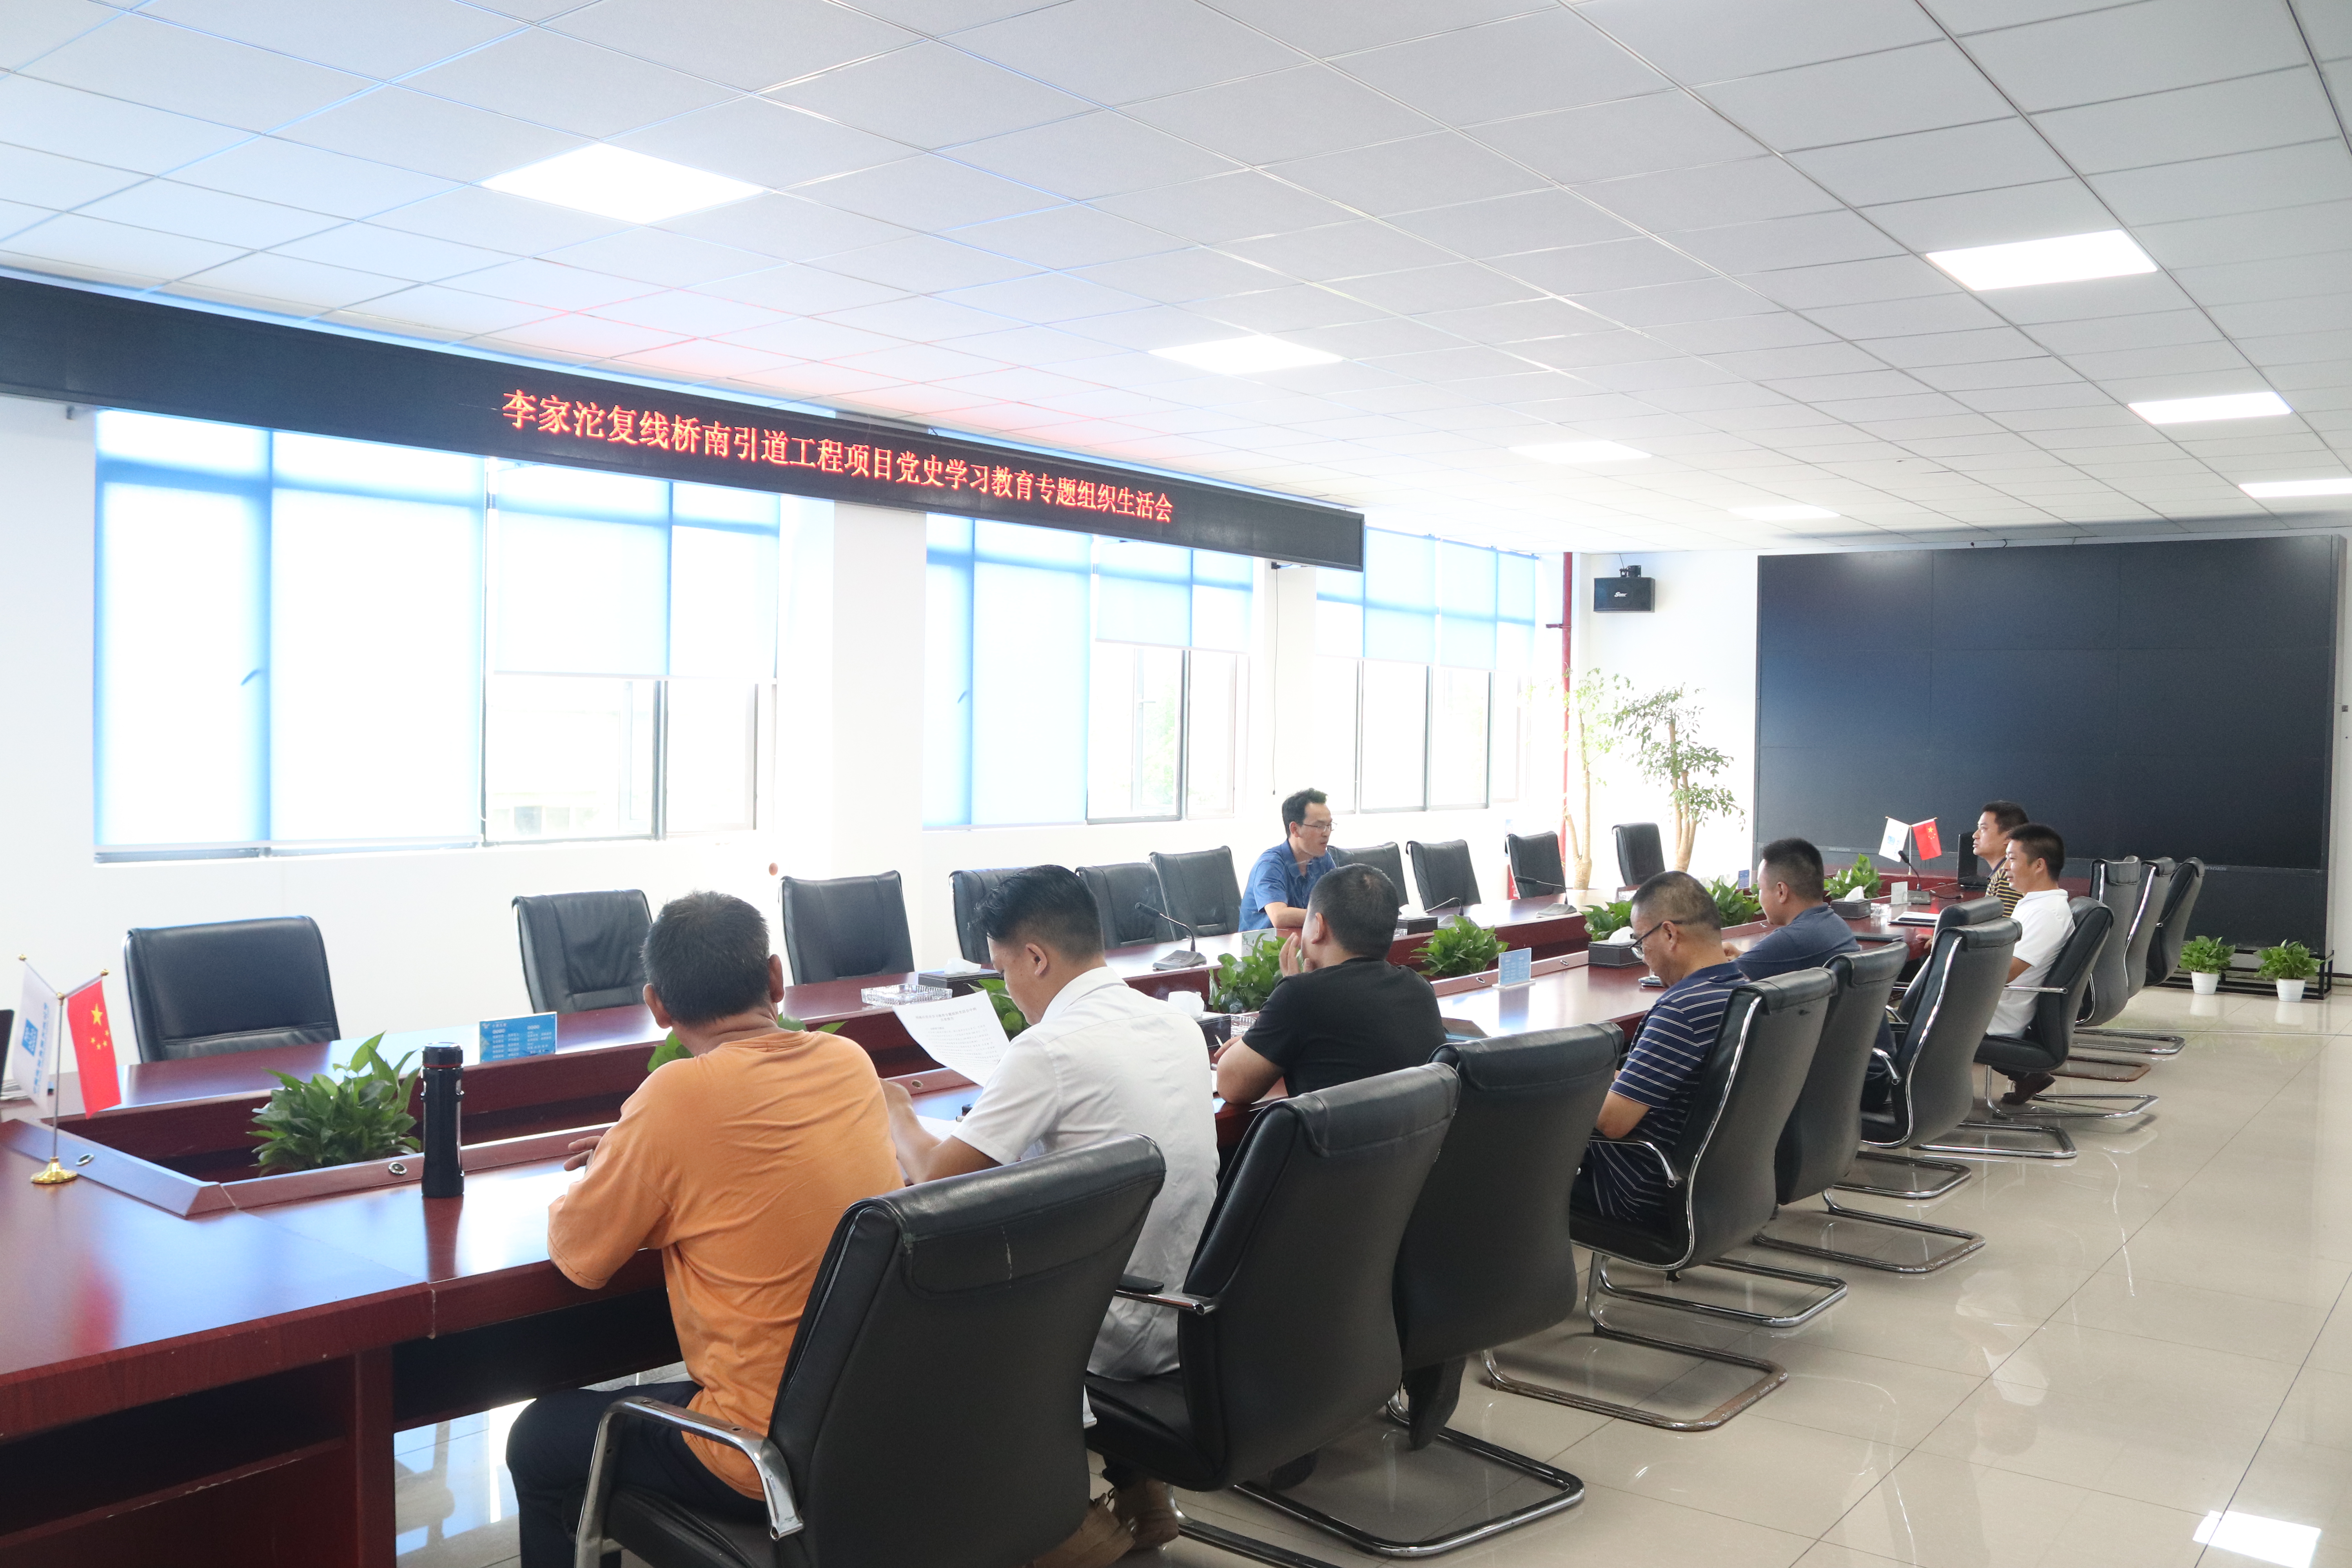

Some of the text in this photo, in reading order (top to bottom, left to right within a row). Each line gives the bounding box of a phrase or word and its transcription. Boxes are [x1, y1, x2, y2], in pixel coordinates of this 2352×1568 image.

[502, 389, 1173, 523] 李家沱复线桥南引道工程项目党史学习教育专题组织生活会
